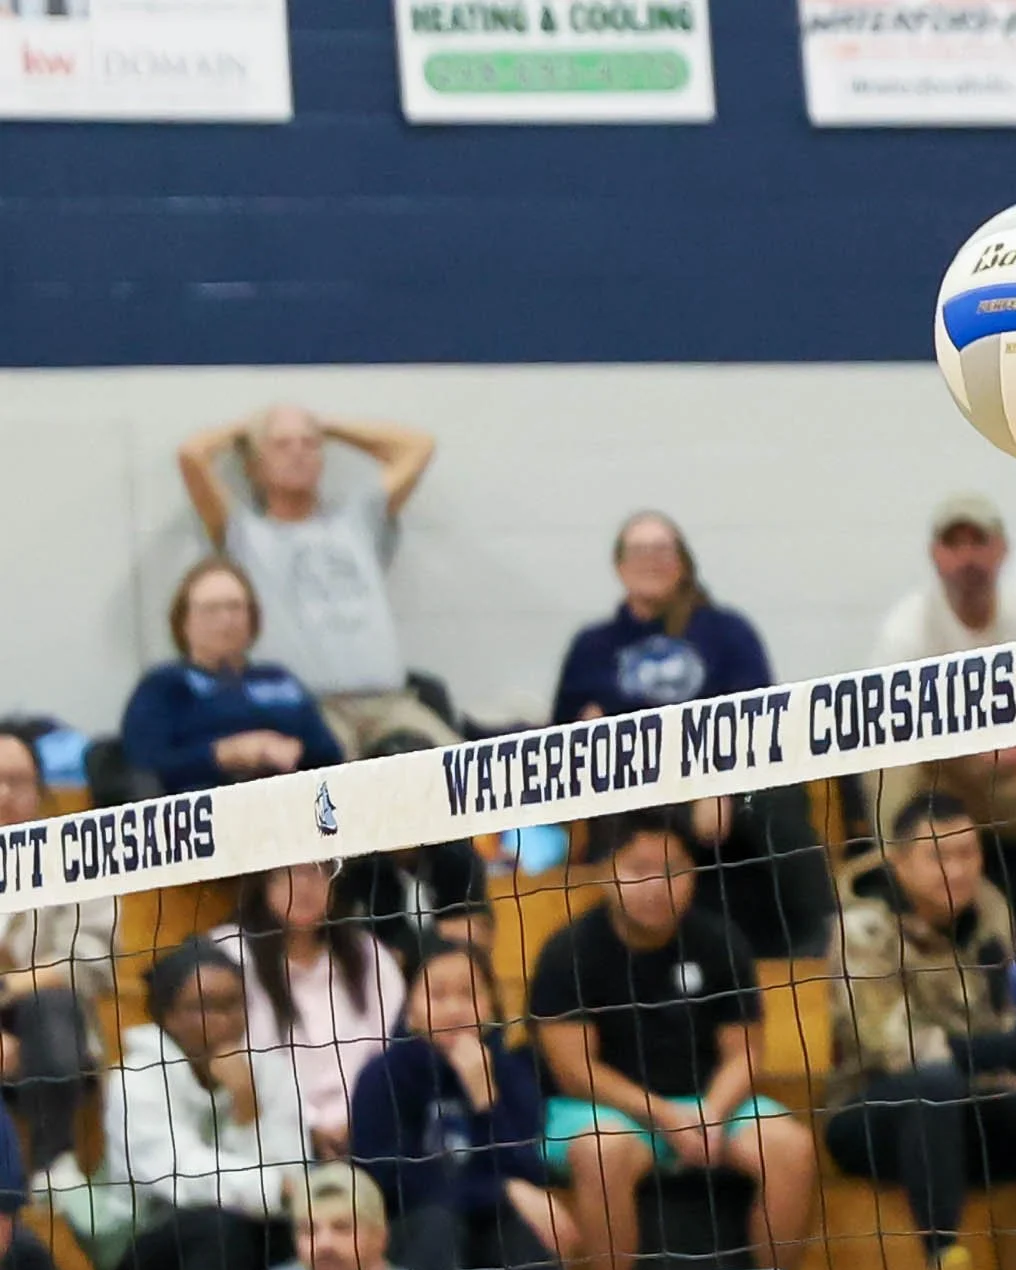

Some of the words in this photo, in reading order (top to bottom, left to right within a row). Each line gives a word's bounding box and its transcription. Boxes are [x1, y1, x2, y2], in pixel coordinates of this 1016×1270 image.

[409, 5, 527, 33] HEATING
[540, 4, 557, 32] &
[570, 4, 694, 33] COOLING
[103, 49, 248, 80] DOMAIN
[443, 714, 662, 815] WATERFORD
[681, 692, 790, 776] MOTT
[809, 651, 1016, 755] CORSAIRS
[61, 795, 215, 882] CORSAIRS
